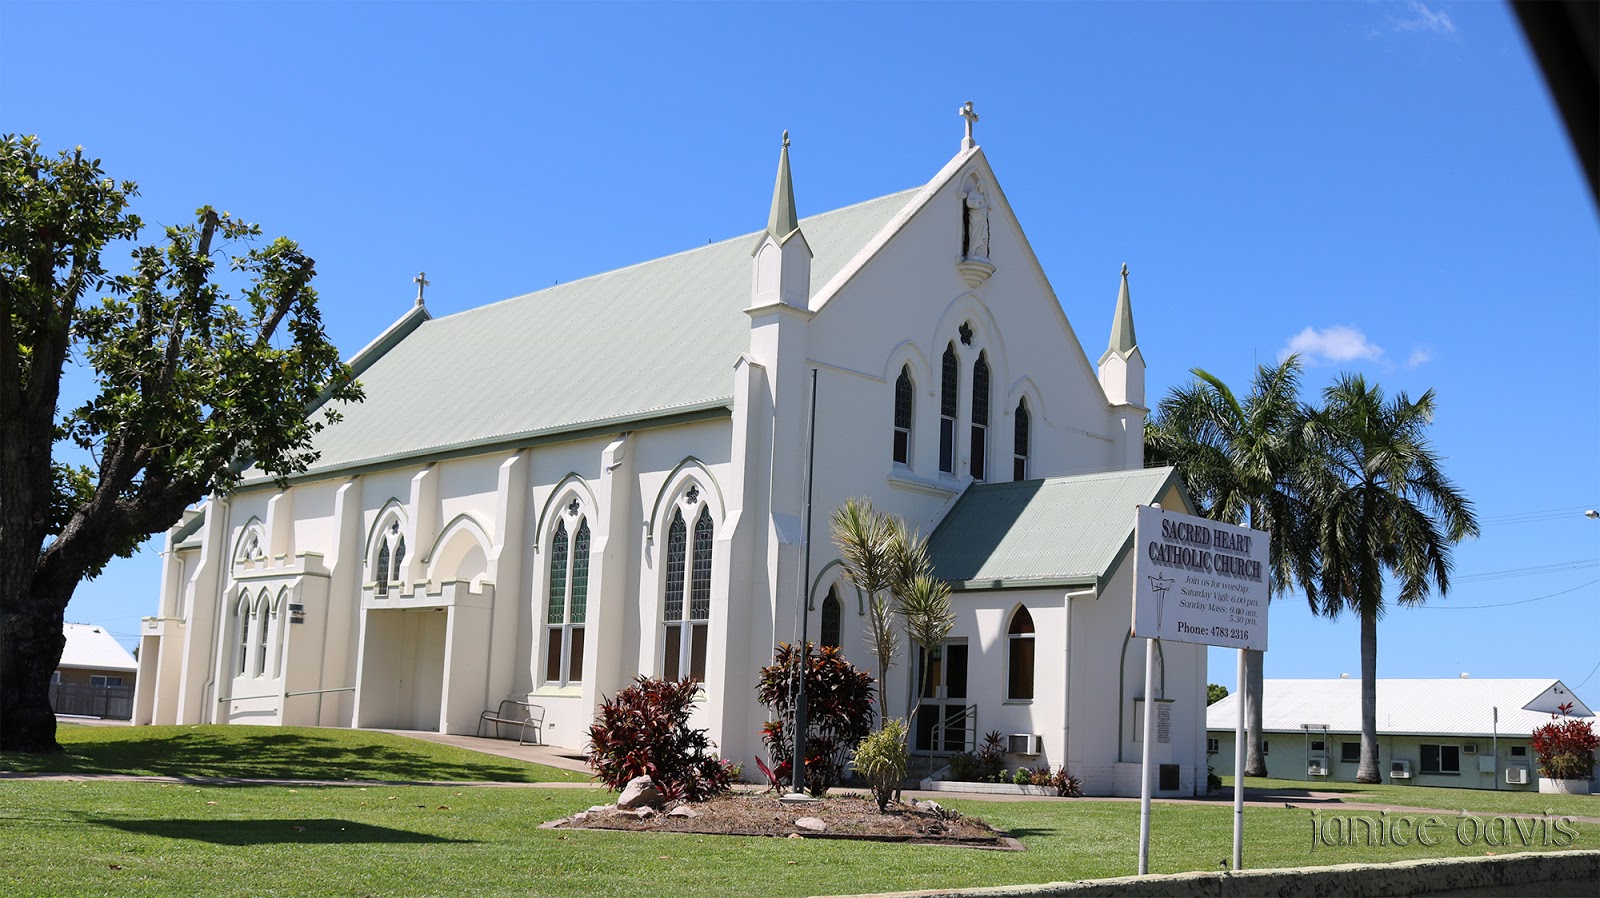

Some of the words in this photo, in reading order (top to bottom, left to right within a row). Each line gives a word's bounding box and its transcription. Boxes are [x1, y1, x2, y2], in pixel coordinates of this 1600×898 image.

[1162, 519, 1211, 547] SACRED
[1213, 529, 1252, 554] HEART
[1149, 541, 1211, 570] CATHOLIC
[1213, 553, 1261, 579] CHURCH
[1185, 576, 1200, 584] Join
[1211, 579, 1221, 588] for
[1222, 583, 1250, 594] worship:
[1180, 587, 1212, 600] Saturday
[1213, 592, 1229, 602] Vigil:
[1231, 595, 1246, 604] 6.00
[1246, 599, 1259, 607] pm.
[1180, 599, 1207, 612] Sunday
[1208, 603, 1228, 613] Mass:
[1229, 614, 1244, 624] 5.30
[1244, 617, 1257, 626] pm.
[1177, 621, 1209, 636] Phone:
[1210, 626, 1229, 638] 4783
[1230, 629, 1249, 641] 2316
